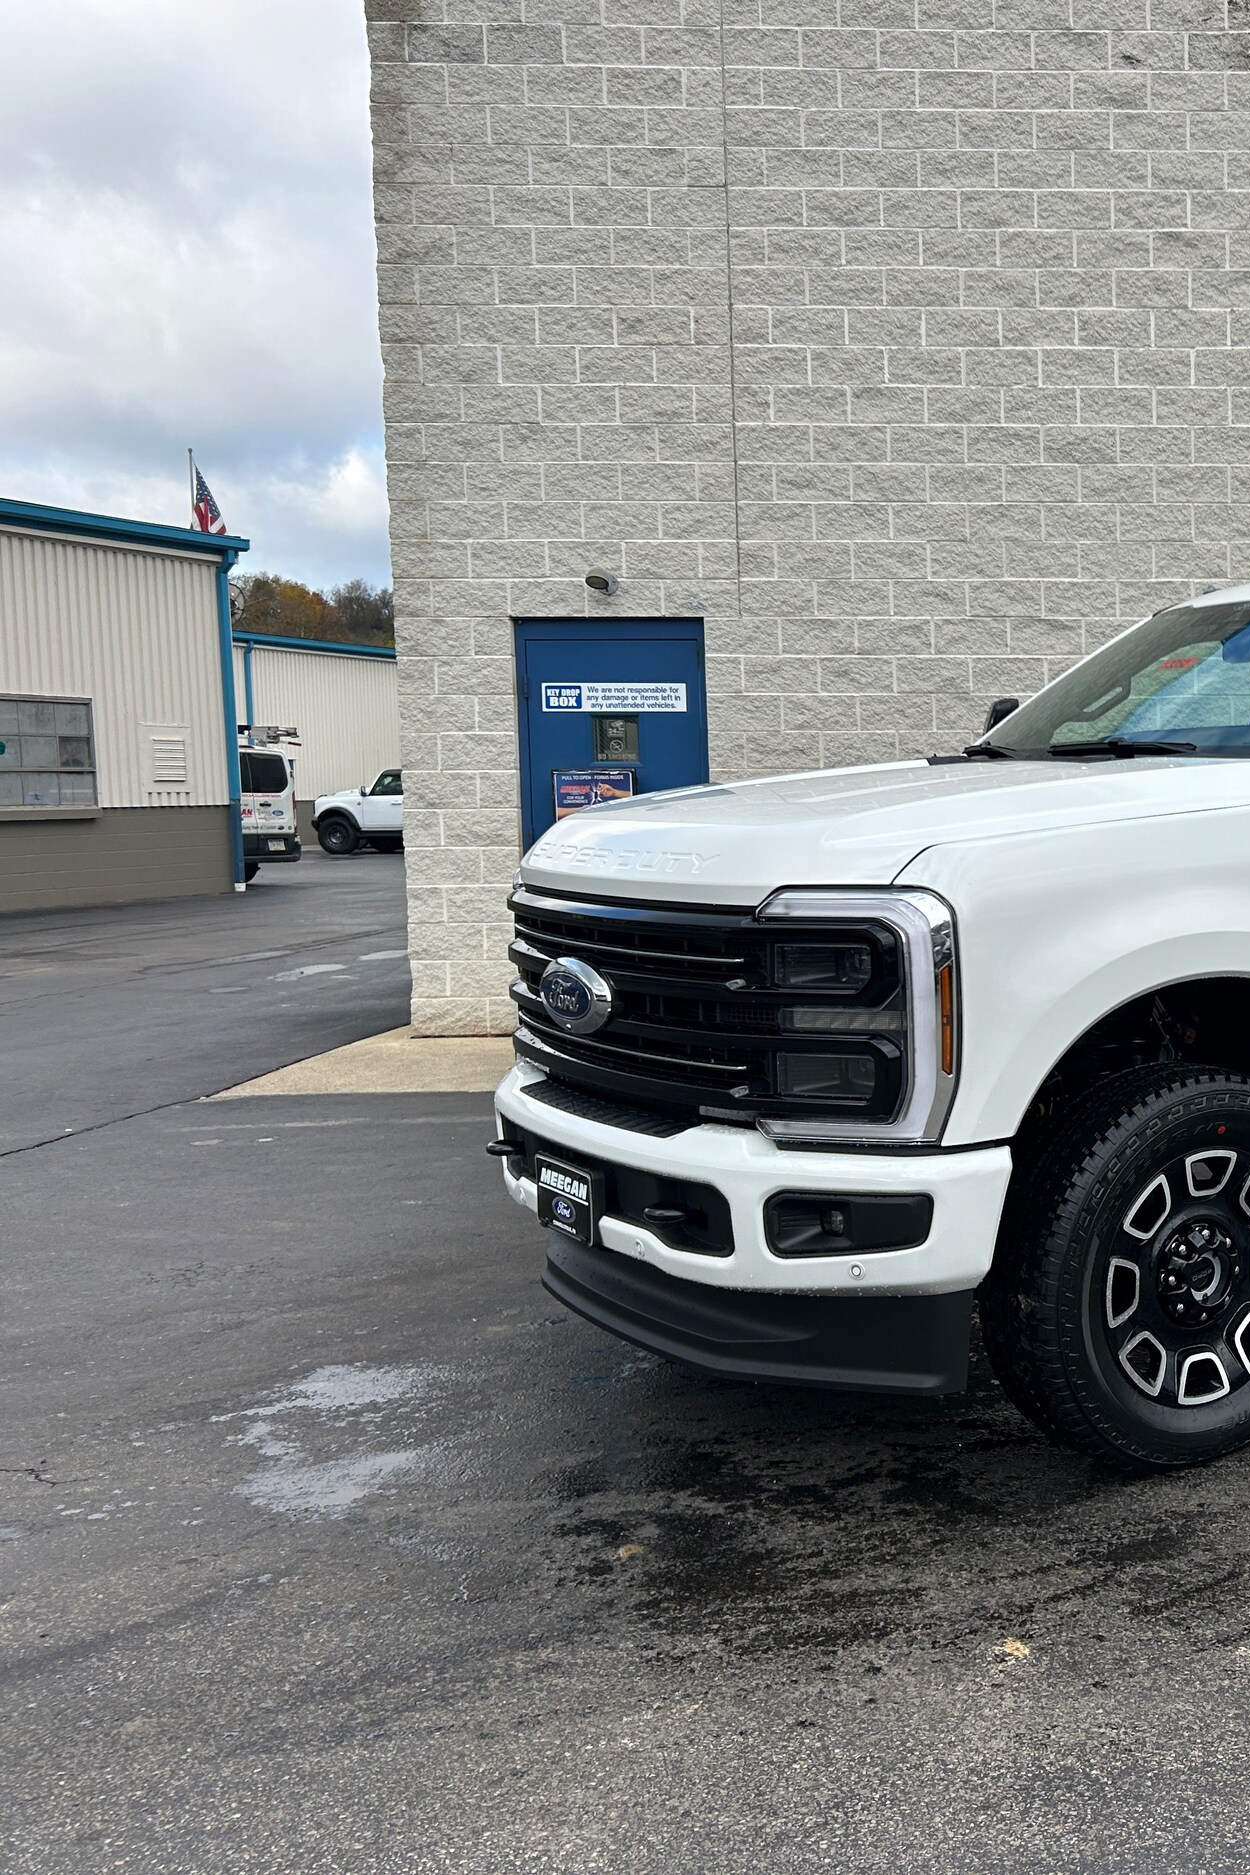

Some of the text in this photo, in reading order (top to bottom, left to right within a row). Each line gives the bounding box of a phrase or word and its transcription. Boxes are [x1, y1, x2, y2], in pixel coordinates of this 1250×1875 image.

[547, 688, 580, 697] KEY DROP
[627, 686, 668, 695] responsible
[549, 696, 577, 707] BOX
[613, 850, 721, 873] DUTY
[550, 977, 580, 1012] Ford
[540, 1167, 588, 1200] MEEGAN
[557, 1201, 571, 1218] Ford
